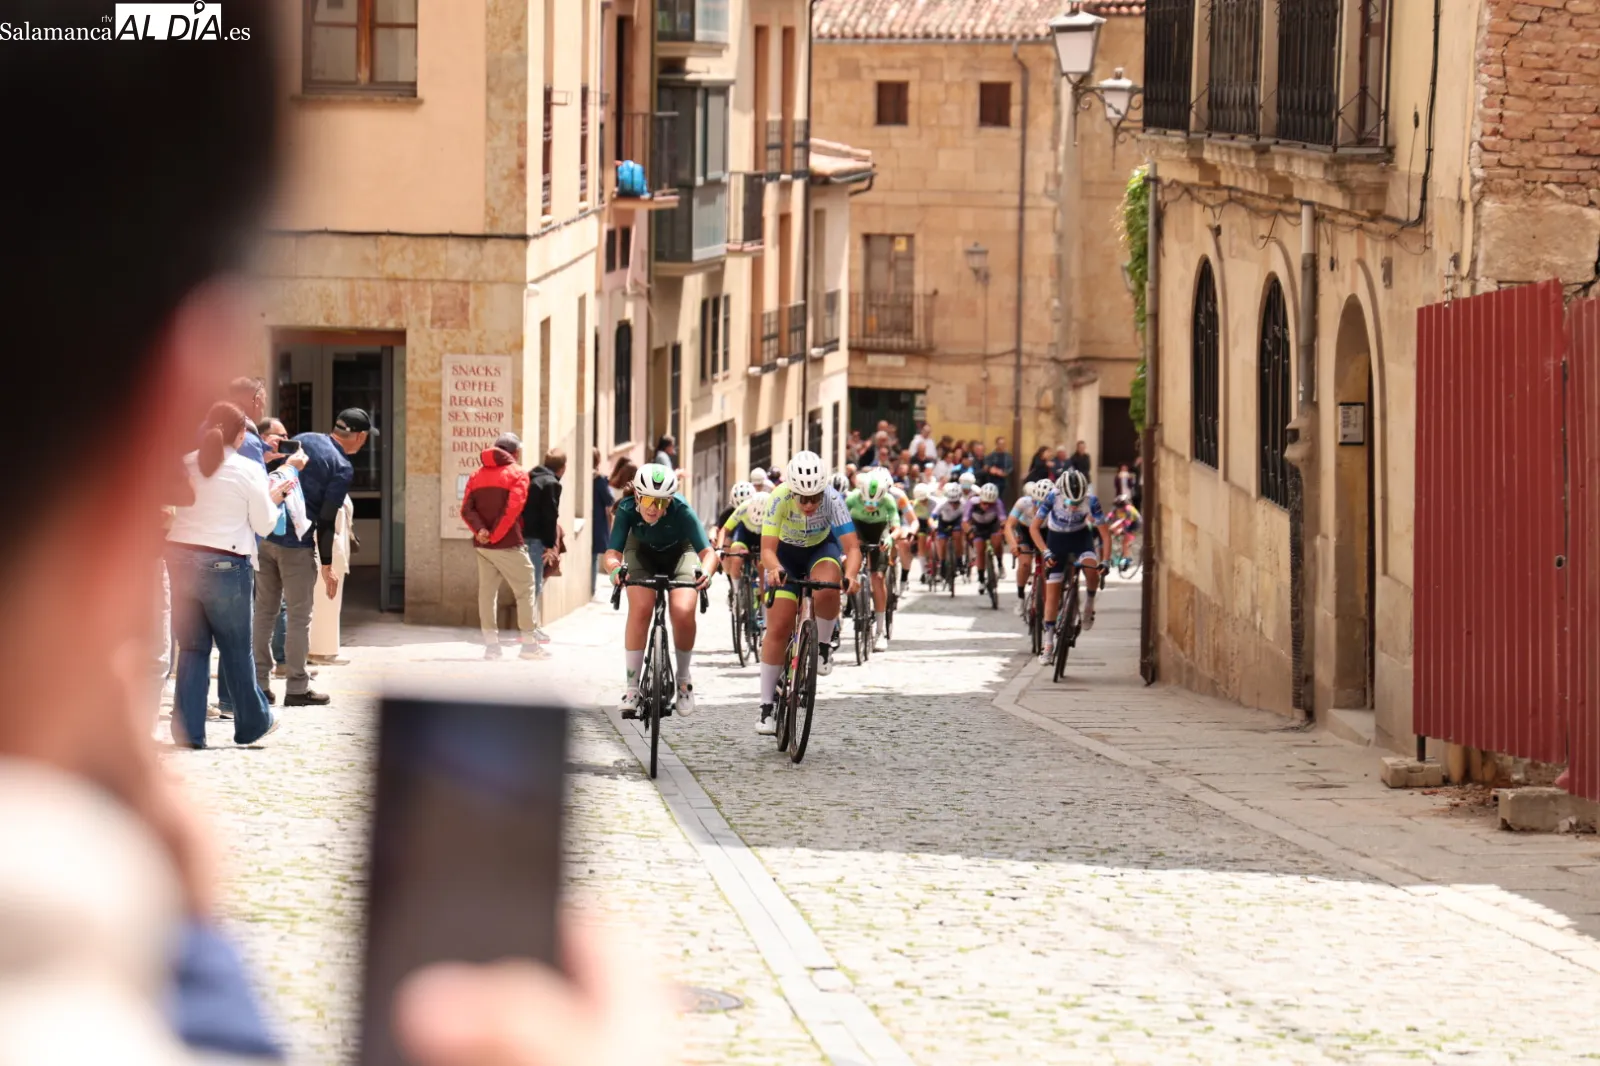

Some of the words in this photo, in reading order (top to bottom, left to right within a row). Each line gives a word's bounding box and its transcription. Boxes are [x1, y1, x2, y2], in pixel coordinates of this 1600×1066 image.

[451, 364, 501, 377] SNACKS
[455, 380, 498, 392] COFFEE
[449, 395, 504, 407] REGALOS
[448, 411, 470, 422] SEX
[474, 411, 504, 423] SHOP
[452, 426, 501, 438] BEBIDAS
[452, 441, 492, 453] DRINK
